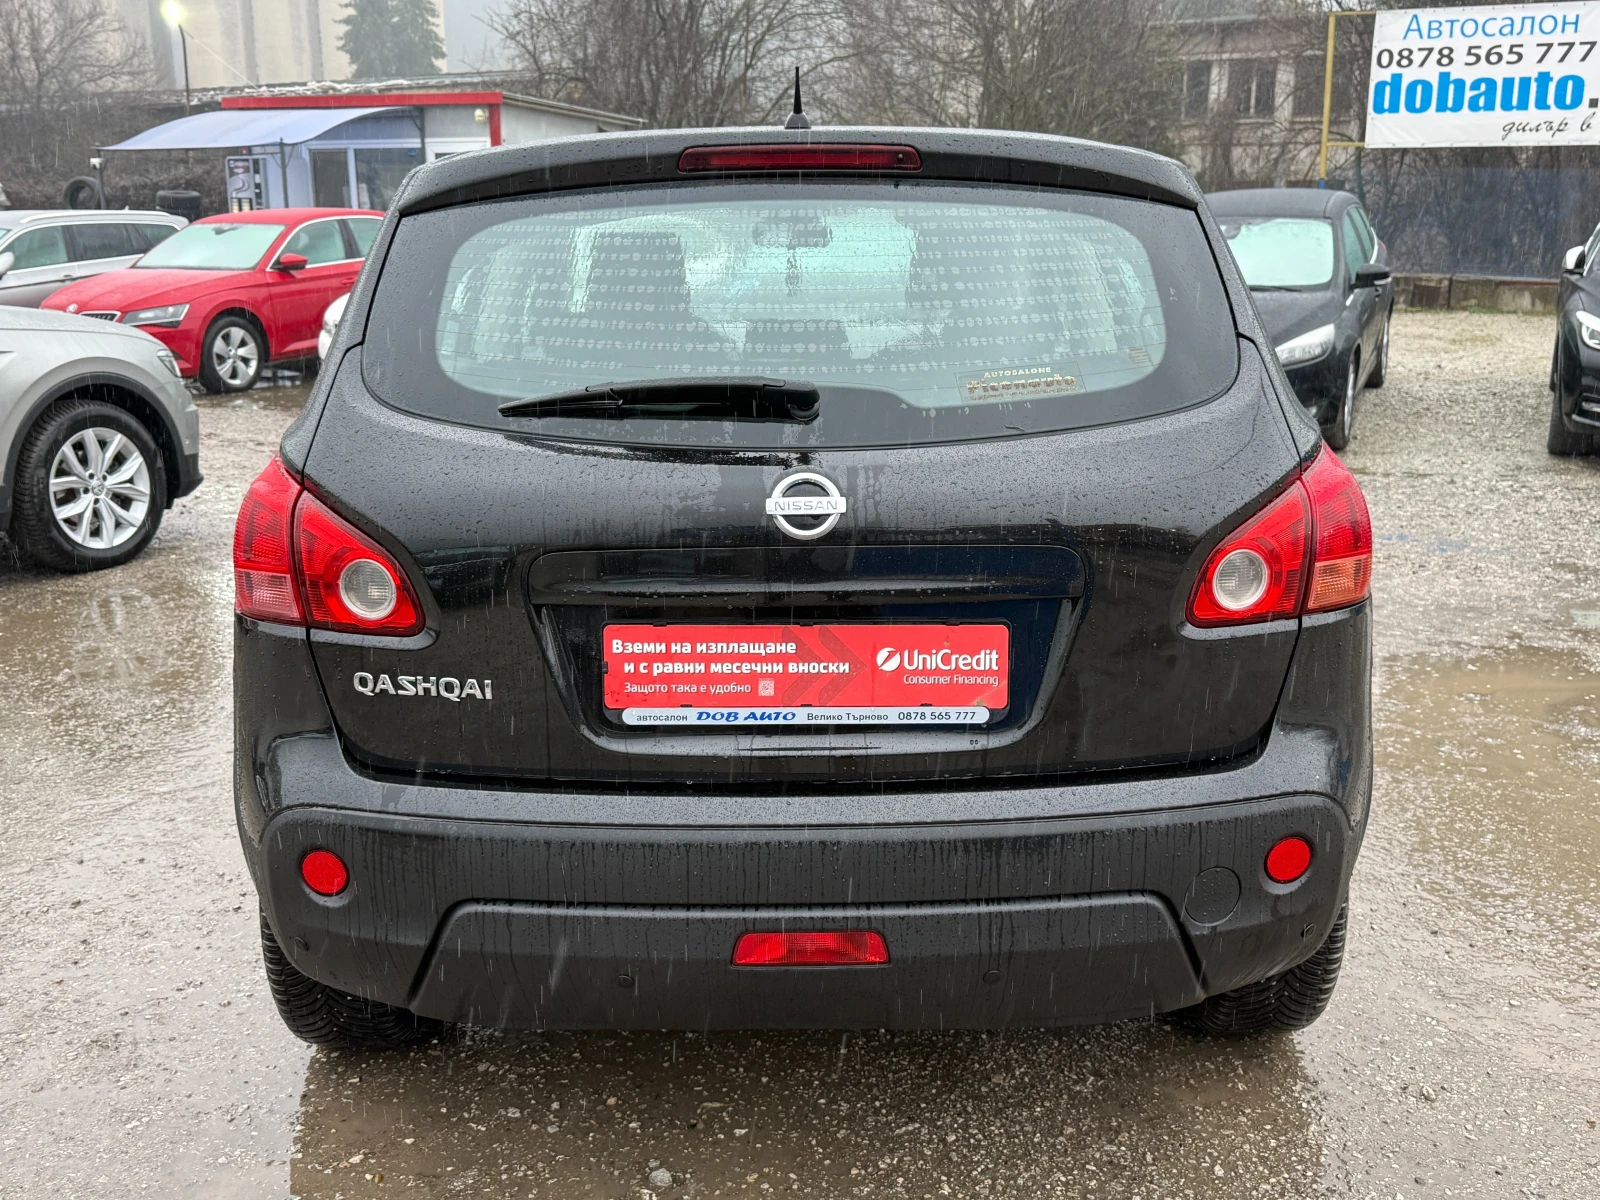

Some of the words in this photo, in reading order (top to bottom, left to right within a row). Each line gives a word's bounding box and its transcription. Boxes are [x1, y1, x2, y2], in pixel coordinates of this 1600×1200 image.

[1402, 13, 1580, 41] Автосалон
[1376, 46, 1455, 69] 0878
[1464, 43, 1524, 66] 565
[1535, 40, 1598, 64] 777
[1502, 117, 1569, 141] дилър
[983, 366, 1052, 378] AUTOSALONE
[774, 500, 838, 511] NISSAN
[612, 639, 666, 654] Вземи
[671, 642, 692, 654] на
[696, 642, 797, 656] изплащане
[903, 649, 999, 671] UniCredit
[623, 662, 635, 674] и
[639, 662, 649, 673] с
[652, 662, 706, 677] равни
[710, 662, 783, 674] месечни
[788, 662, 850, 674] вноски
[353, 671, 493, 702] QASHQAI
[624, 682, 668, 694] Защото
[671, 684, 698, 693] така
[700, 684, 707, 693] е
[709, 682, 752, 695] удобно
[903, 674, 951, 684] Consumer
[953, 674, 999, 687] Financing
[636, 714, 688, 722] автосалон
[696, 711, 739, 722] DOB
[744, 711, 796, 721] AUTO
[807, 712, 843, 721] Велико
[845, 712, 889, 722] Търново
[898, 711, 926, 721] 0878
[930, 711, 951, 720] 565
[955, 711, 976, 720] 777
